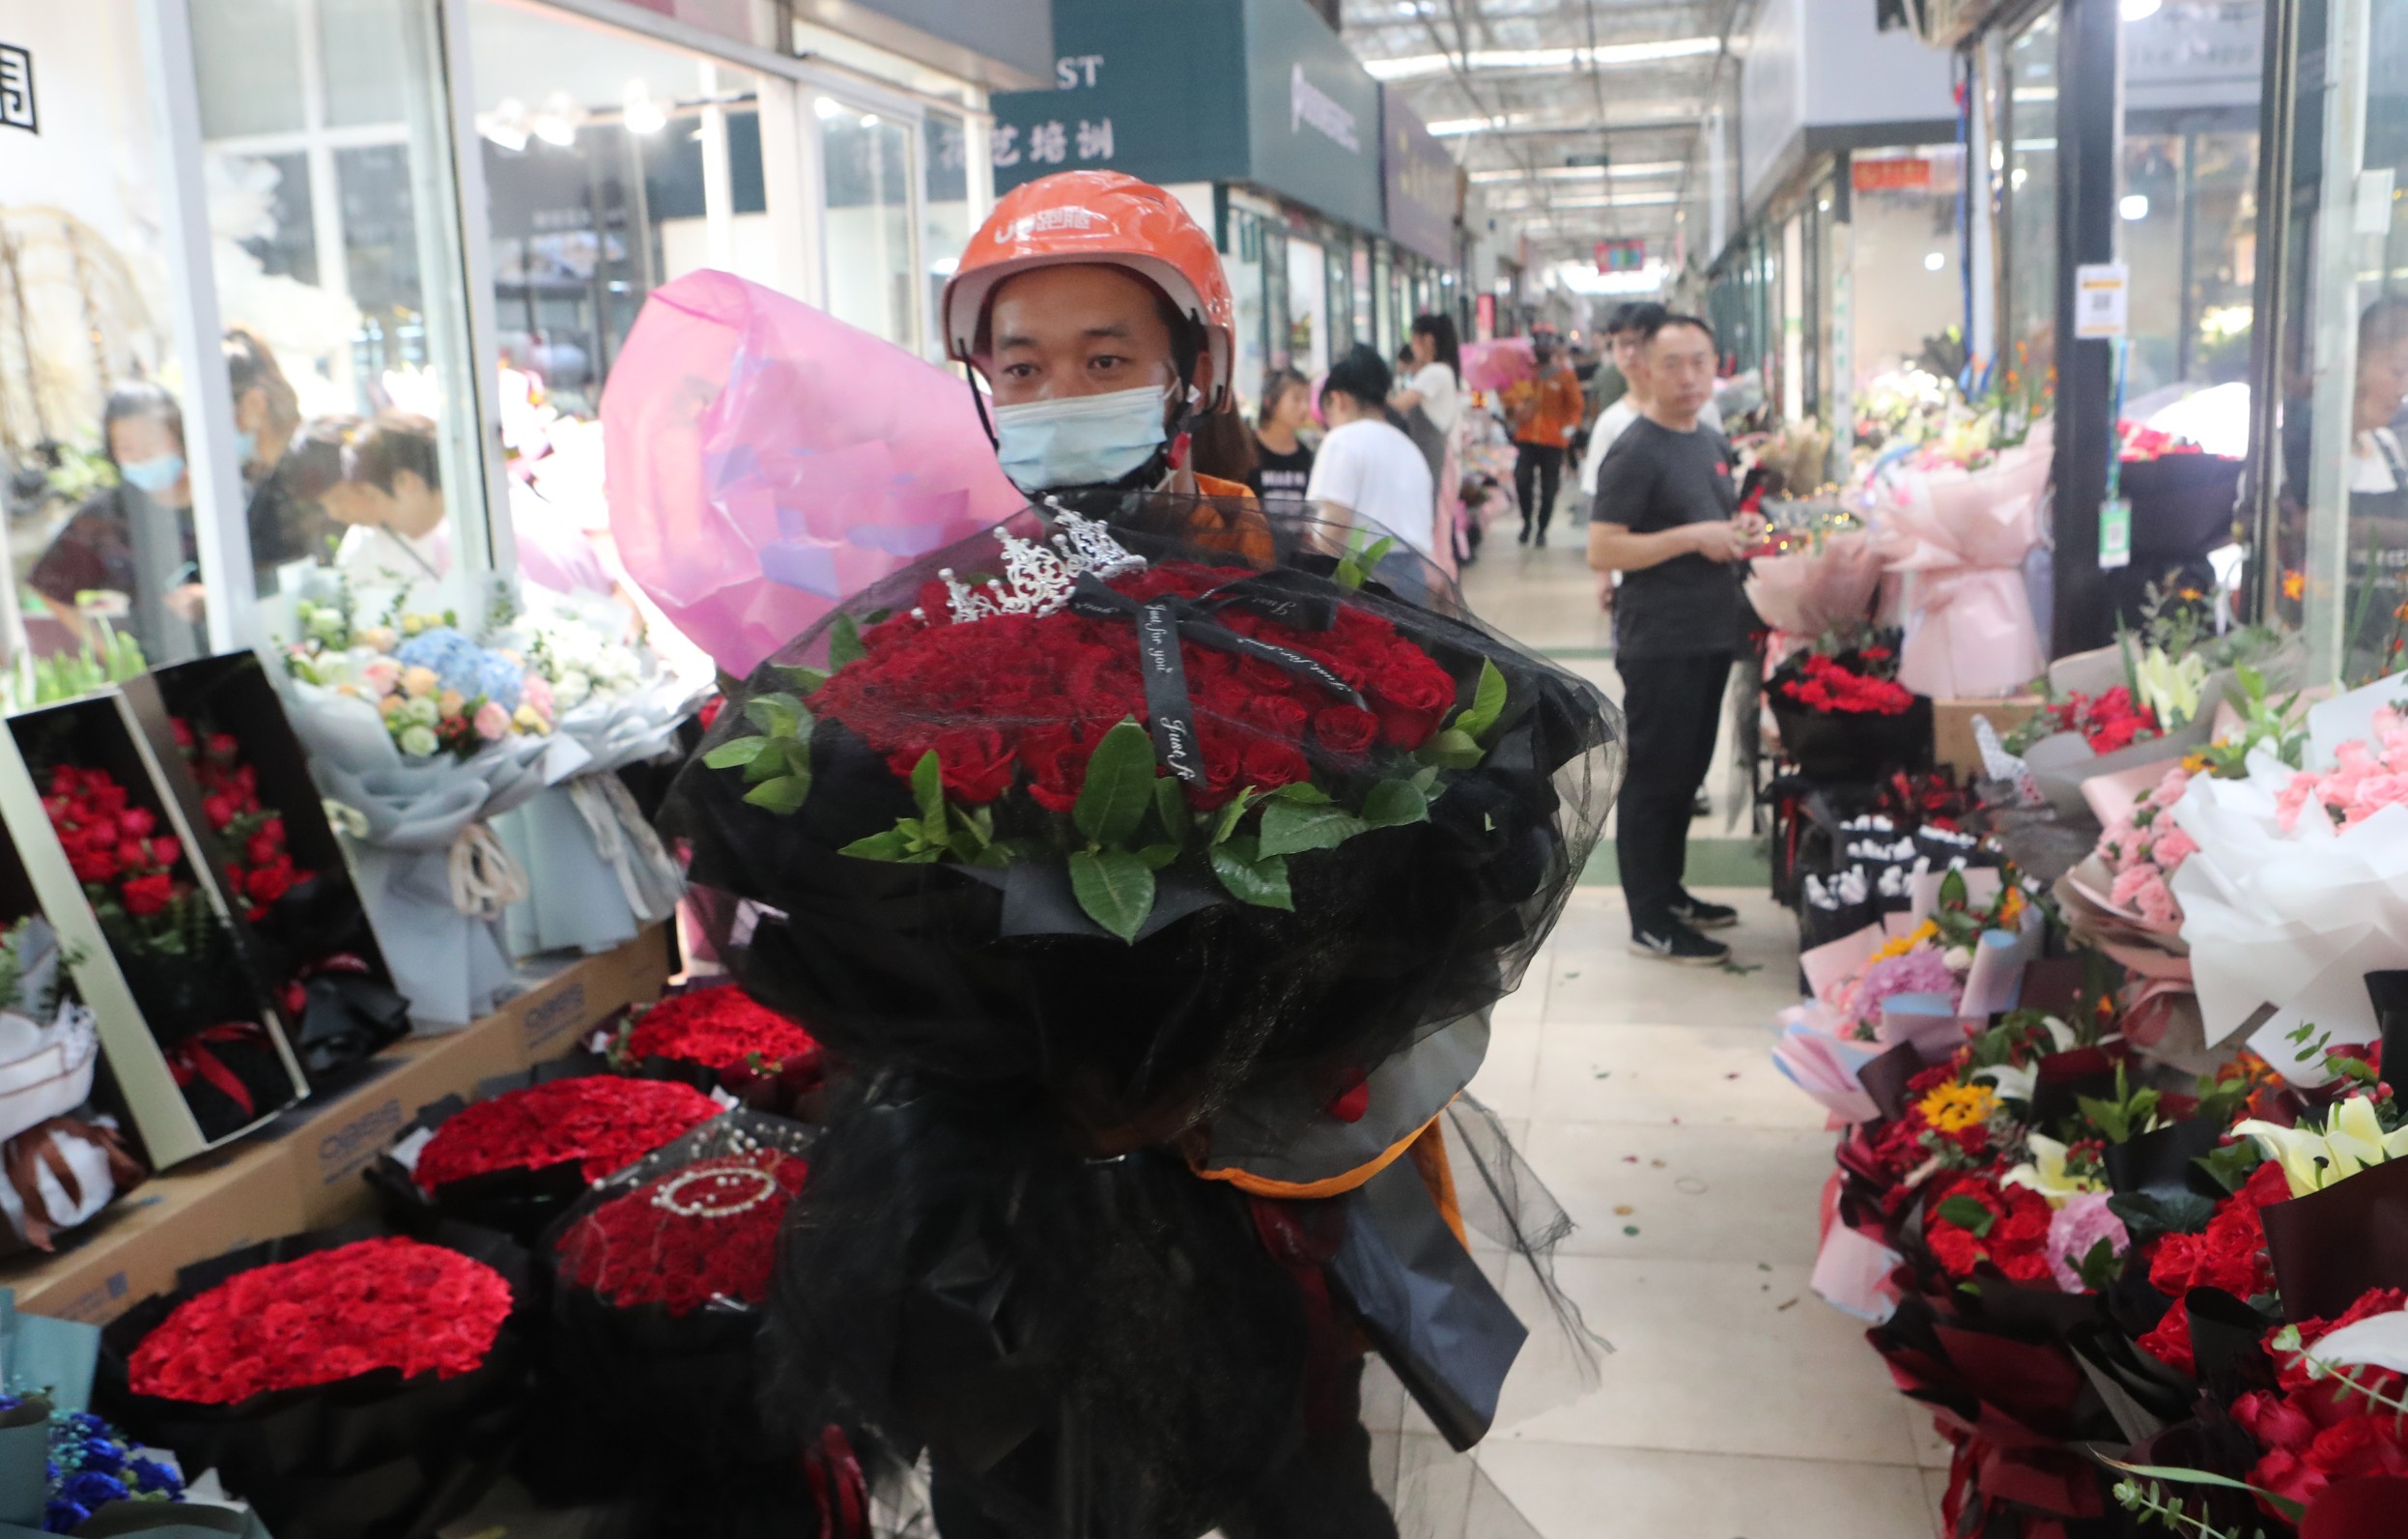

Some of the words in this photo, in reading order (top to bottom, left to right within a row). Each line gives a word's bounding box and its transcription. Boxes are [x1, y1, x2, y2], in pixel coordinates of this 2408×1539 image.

[994, 205, 1091, 245] U跑腿
[1144, 604, 1167, 623] Just
[1145, 622, 1168, 644] for
[1147, 647, 1167, 671] you
[1310, 663, 1351, 692] Just
[1159, 717, 1187, 757] Just
